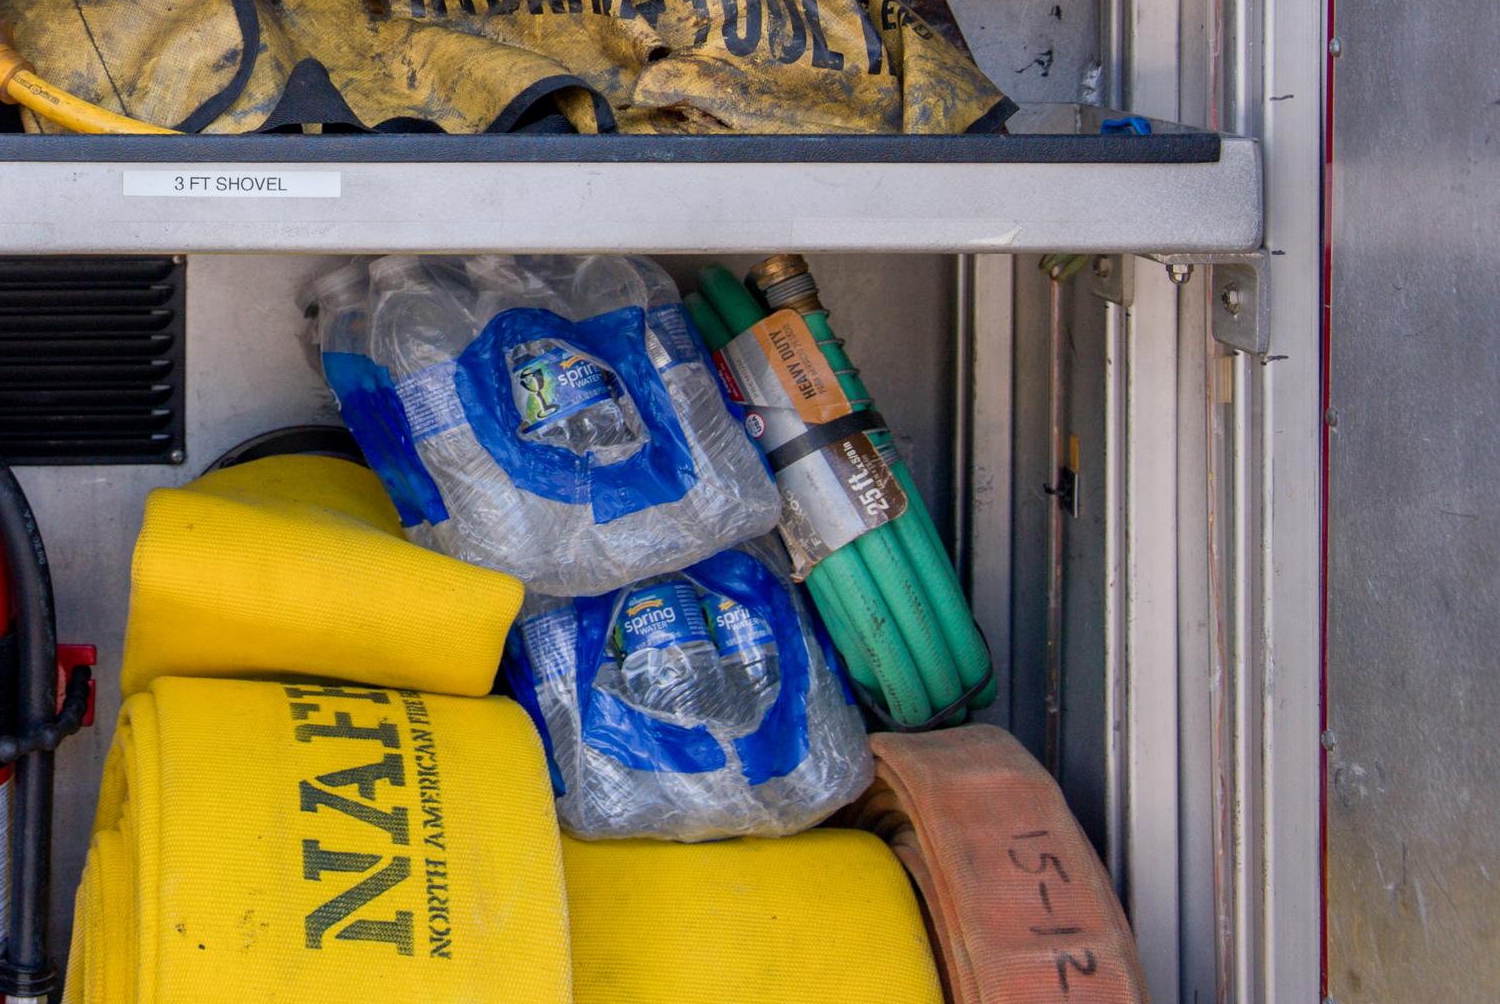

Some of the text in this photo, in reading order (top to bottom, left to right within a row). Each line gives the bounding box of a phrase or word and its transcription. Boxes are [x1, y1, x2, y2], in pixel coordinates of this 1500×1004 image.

[174, 176, 288, 192] 3 FT SHOVEL
[557, 360, 598, 388] sprin
[769, 329, 817, 400] HEAVY DUTY
[574, 374, 601, 388] WATE
[624, 607, 676, 635] spring
[639, 622, 668, 635] WATER
[716, 606, 750, 630] spri
[410, 728, 446, 851] AMERICAN
[425, 858, 452, 959] NORTH
[1008, 830, 1097, 994] 15-12
